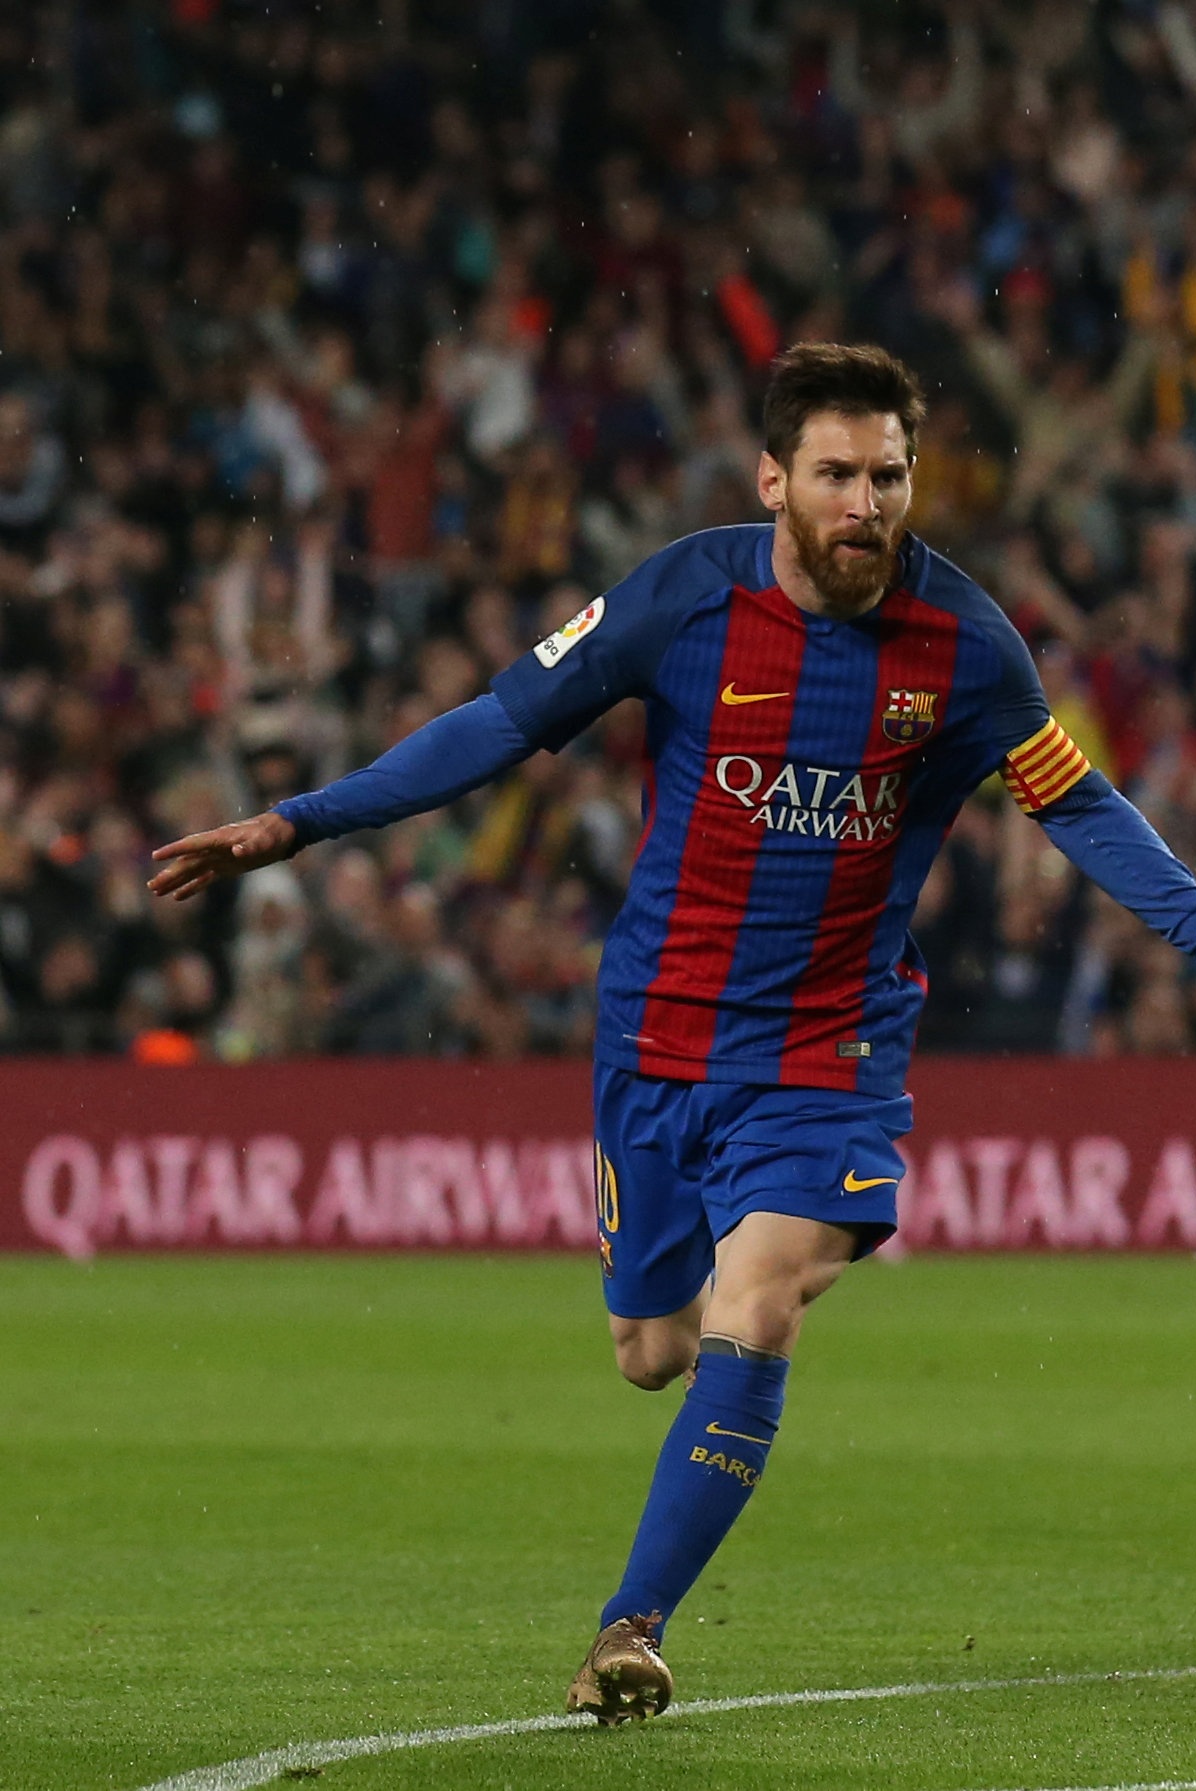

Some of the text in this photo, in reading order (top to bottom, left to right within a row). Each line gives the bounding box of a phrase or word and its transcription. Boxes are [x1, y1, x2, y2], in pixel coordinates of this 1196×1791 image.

[716, 755, 901, 813] QATAR
[750, 804, 895, 841] AIRWAYS
[22, 1135, 600, 1262] QATAR AIRWA
[876, 1136, 1133, 1262] ATAR
